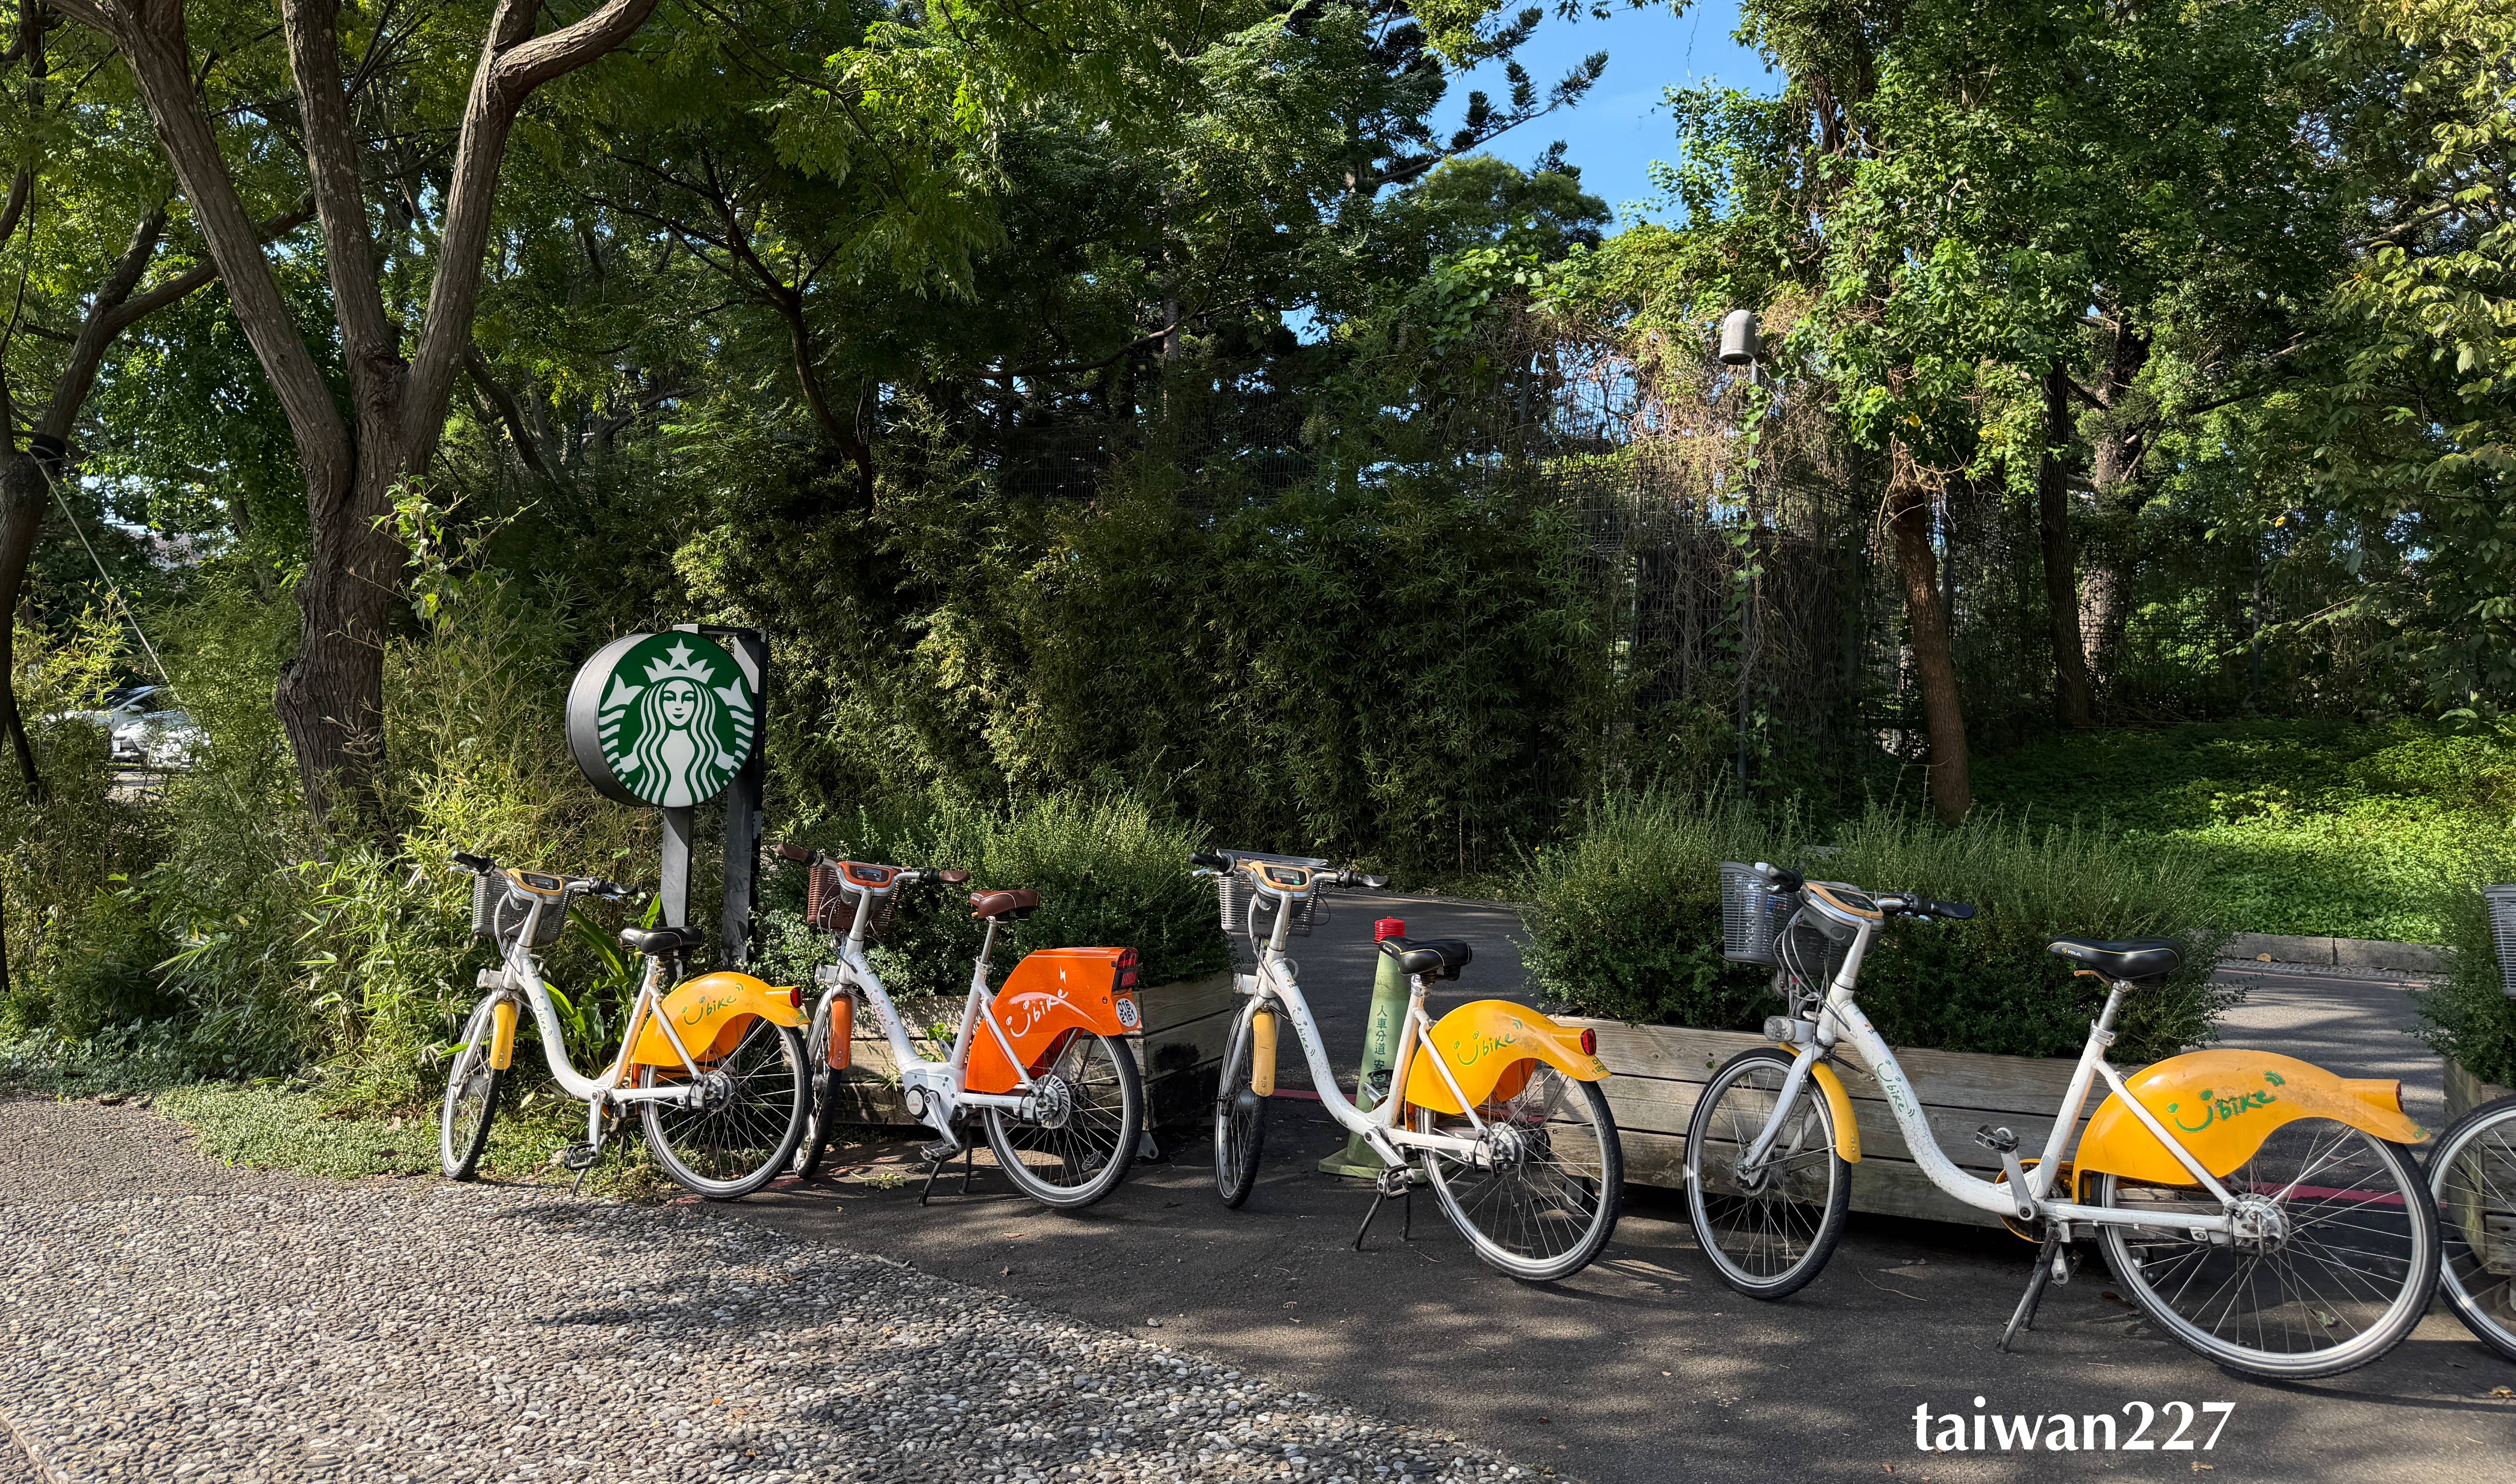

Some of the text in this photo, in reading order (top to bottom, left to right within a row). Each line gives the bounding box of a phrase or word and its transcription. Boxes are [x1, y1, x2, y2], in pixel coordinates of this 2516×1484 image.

[1118, 1000, 1131, 1012] 016
[1120, 1010, 1136, 1023] 2161
[1374, 1005, 1387, 1055] 人車分道
